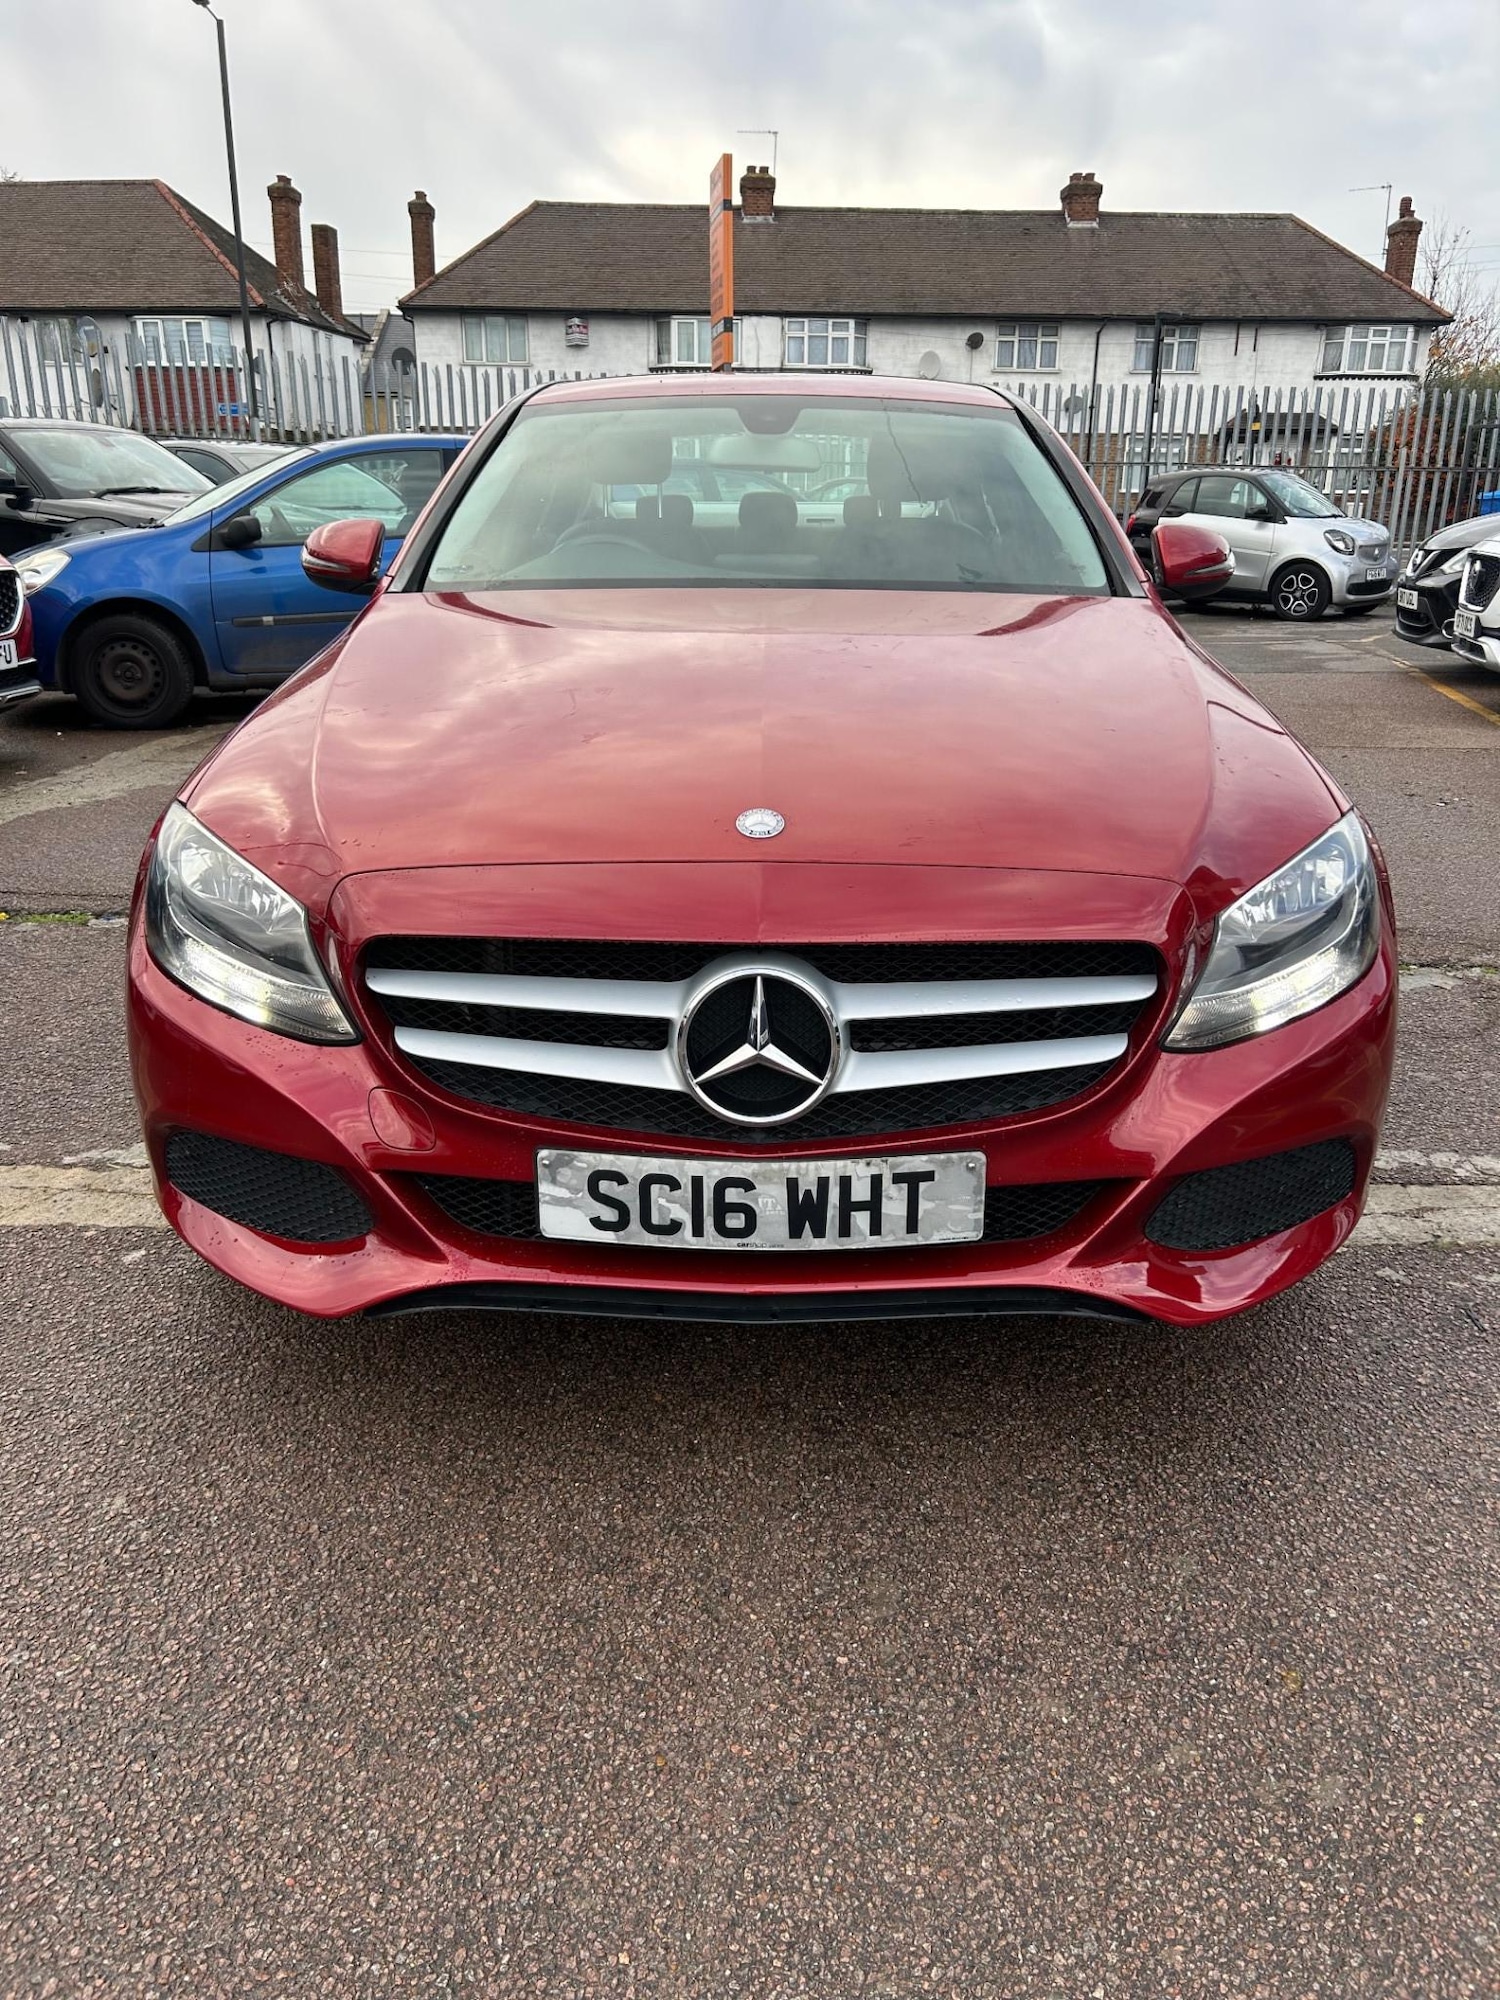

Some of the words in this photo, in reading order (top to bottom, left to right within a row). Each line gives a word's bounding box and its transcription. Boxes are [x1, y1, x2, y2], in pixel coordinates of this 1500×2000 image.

[0, 643, 12, 664] U
[587, 1169, 757, 1239] SC16
[786, 1170, 935, 1239] WHT
